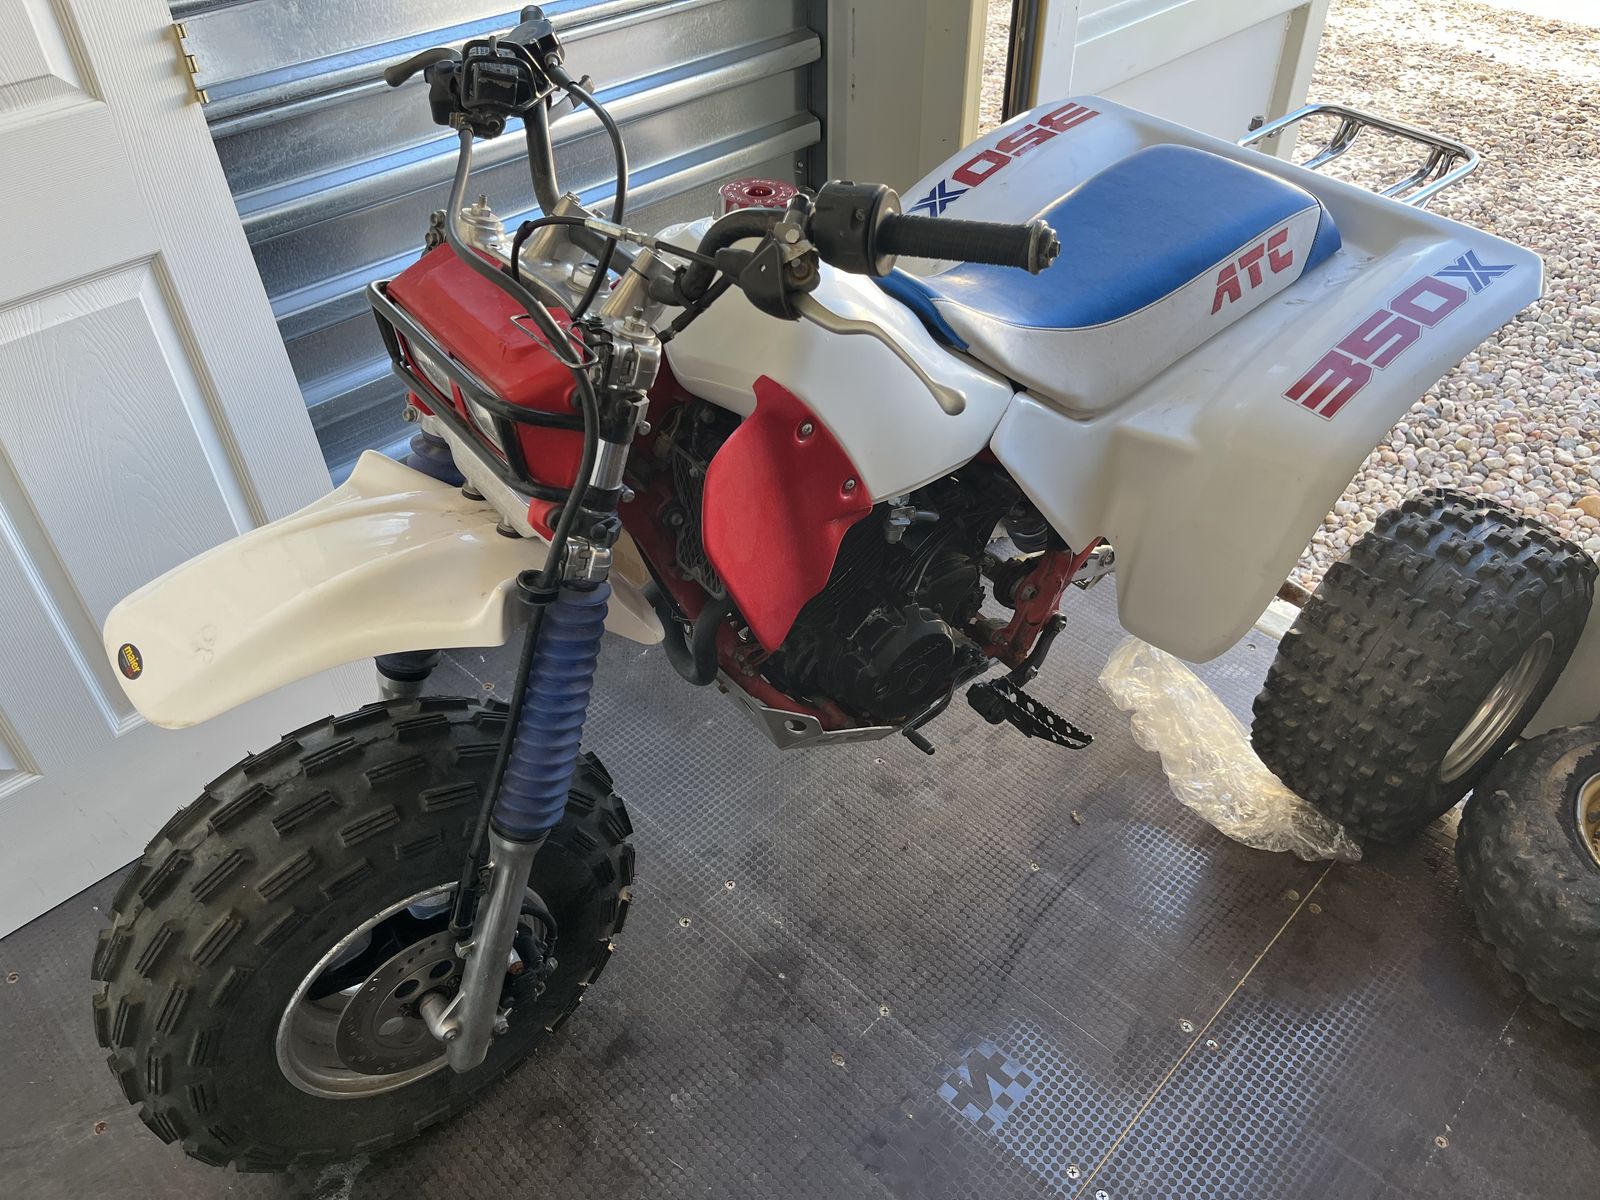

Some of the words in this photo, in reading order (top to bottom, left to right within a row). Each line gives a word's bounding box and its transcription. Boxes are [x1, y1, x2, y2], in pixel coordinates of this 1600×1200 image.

[907, 102, 1101, 217] 350X
[1210, 227, 1293, 315] ATC
[1283, 249, 1517, 419] 350X
[123, 645, 141, 672] maier
